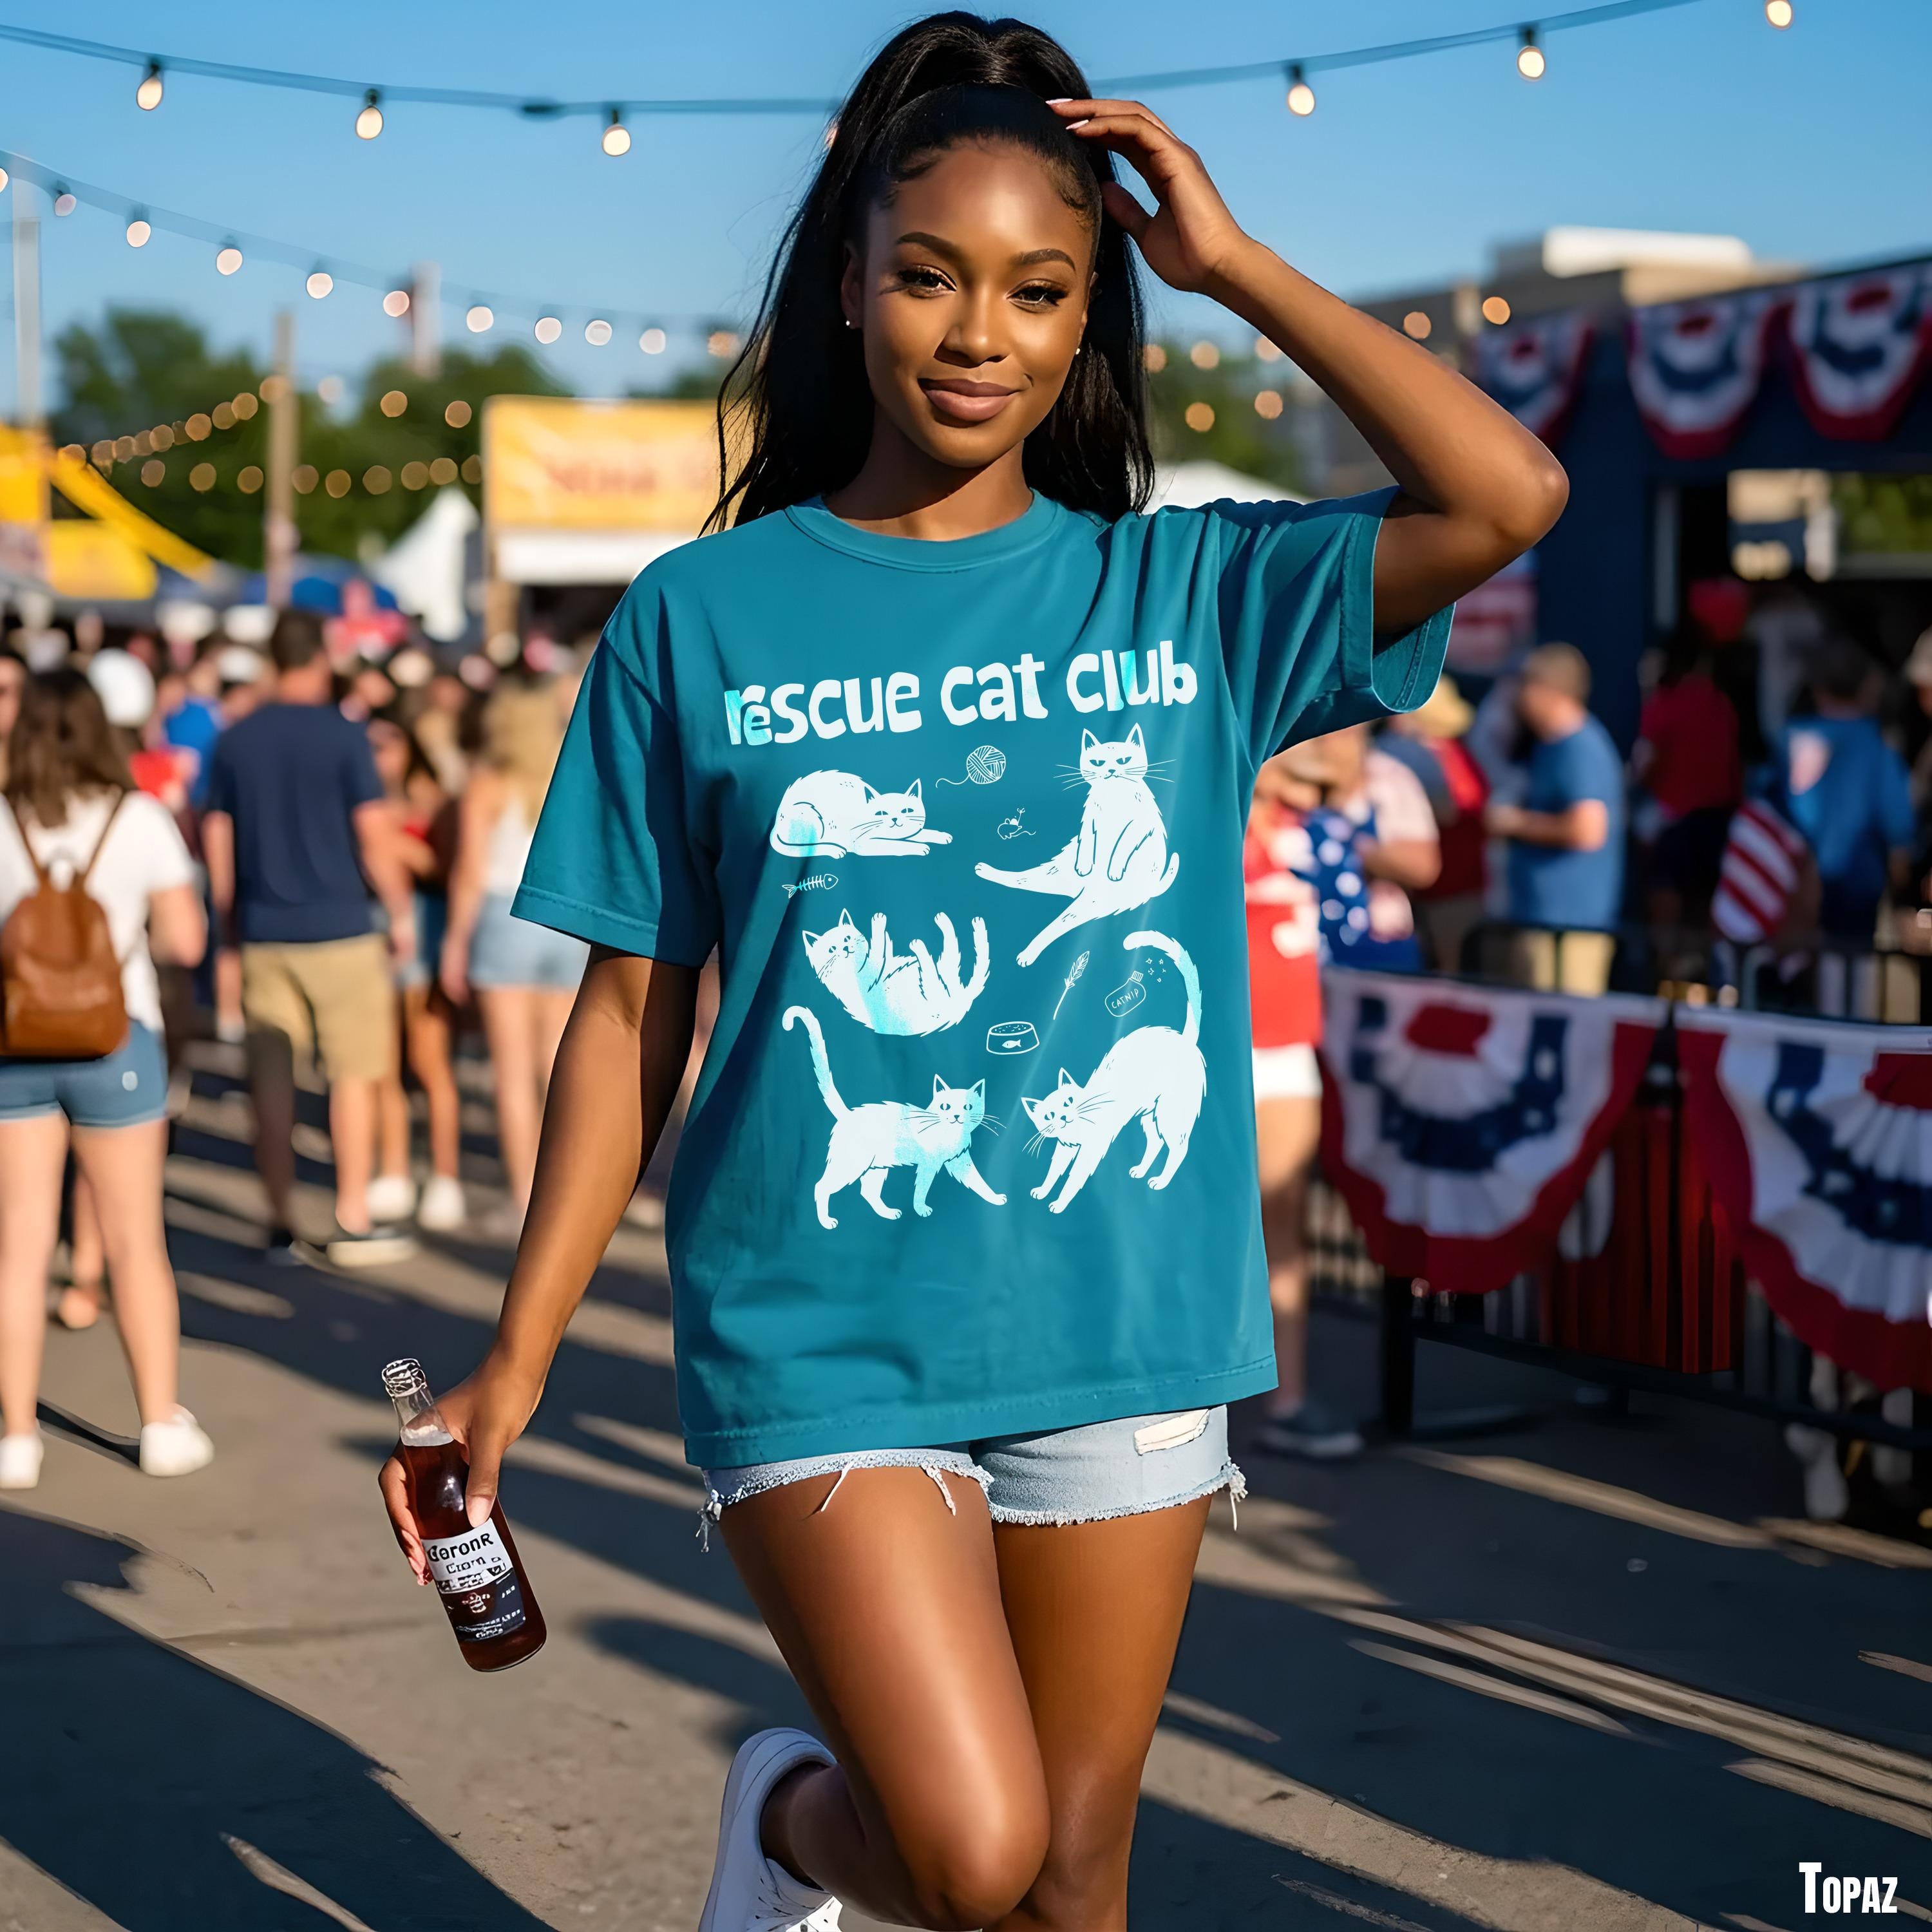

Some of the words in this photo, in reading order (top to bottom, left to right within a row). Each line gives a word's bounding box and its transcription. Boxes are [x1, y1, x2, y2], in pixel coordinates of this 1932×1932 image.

[724, 672, 922, 745] rescue
[941, 654, 1048, 726] cat
[1066, 640, 1197, 713] club
[1111, 989, 1139, 1009] CATNIP
